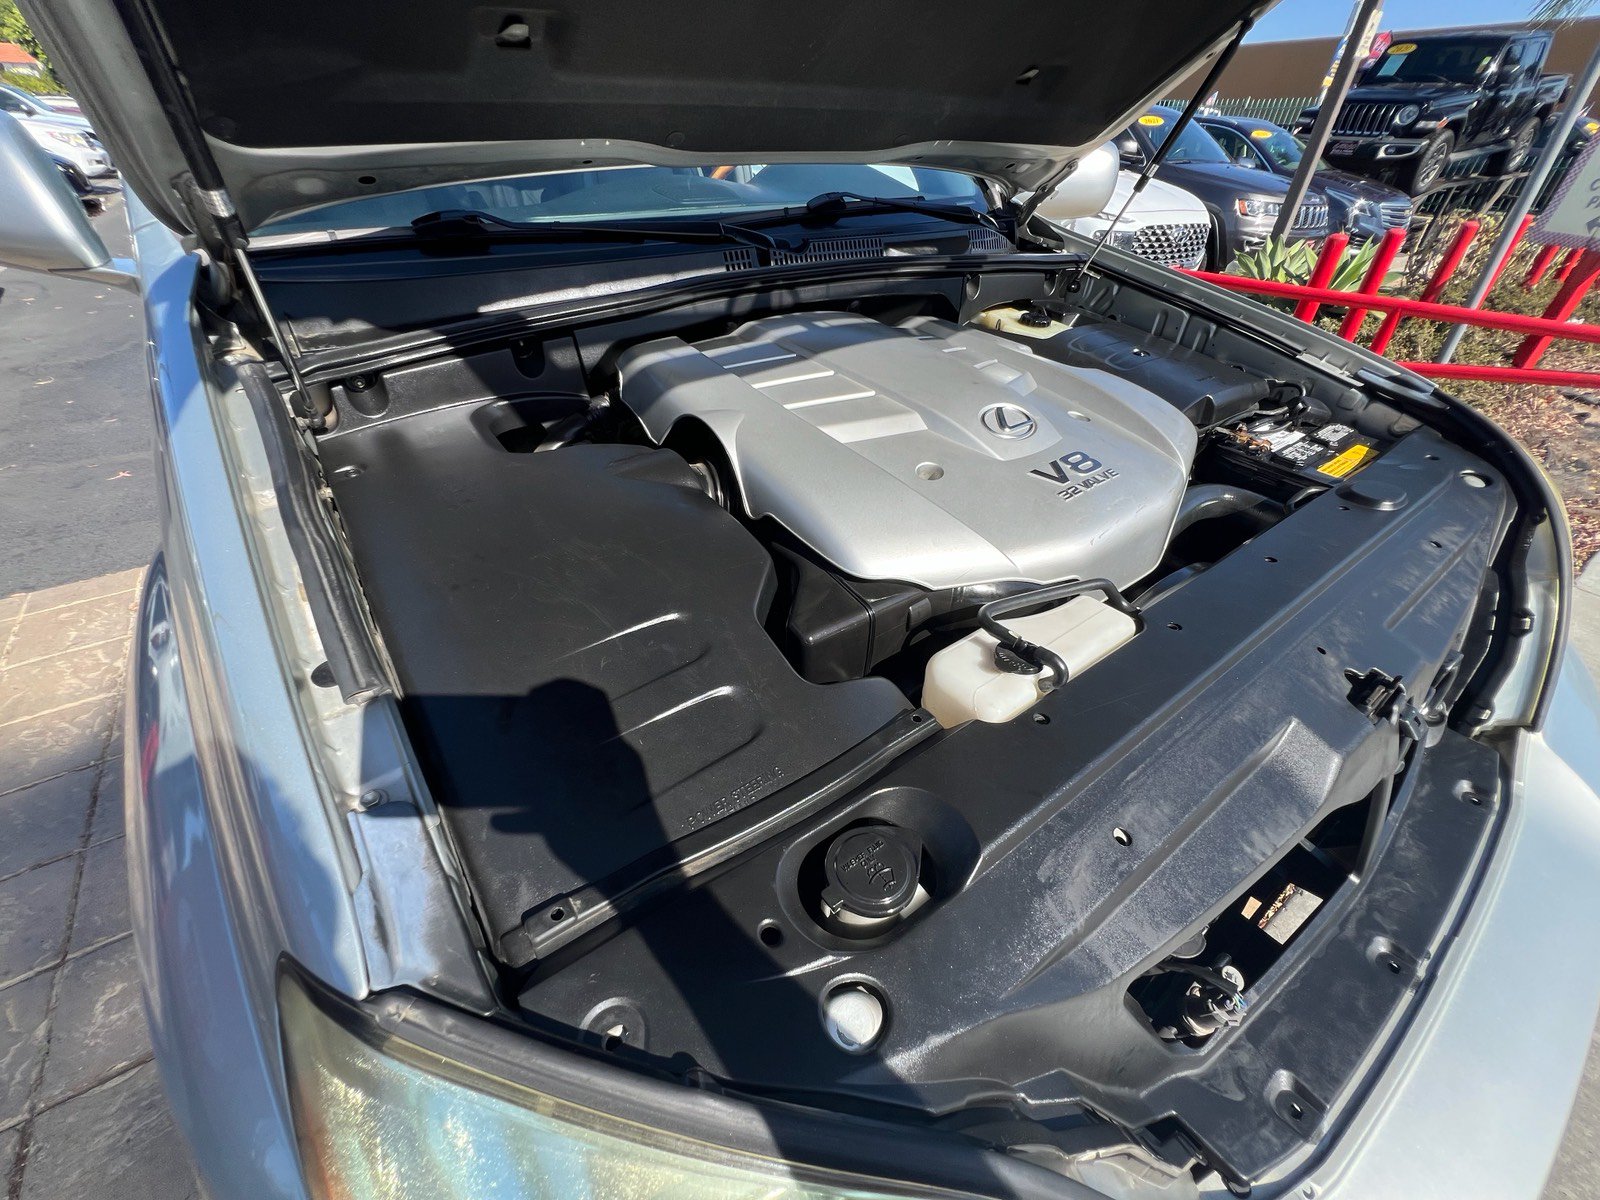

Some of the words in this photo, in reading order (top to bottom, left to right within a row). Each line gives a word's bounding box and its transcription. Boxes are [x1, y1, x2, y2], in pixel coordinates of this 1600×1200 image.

[1029, 451, 1103, 485] V8
[1057, 485, 1084, 502] 32
[1077, 467, 1120, 491] VALVE
